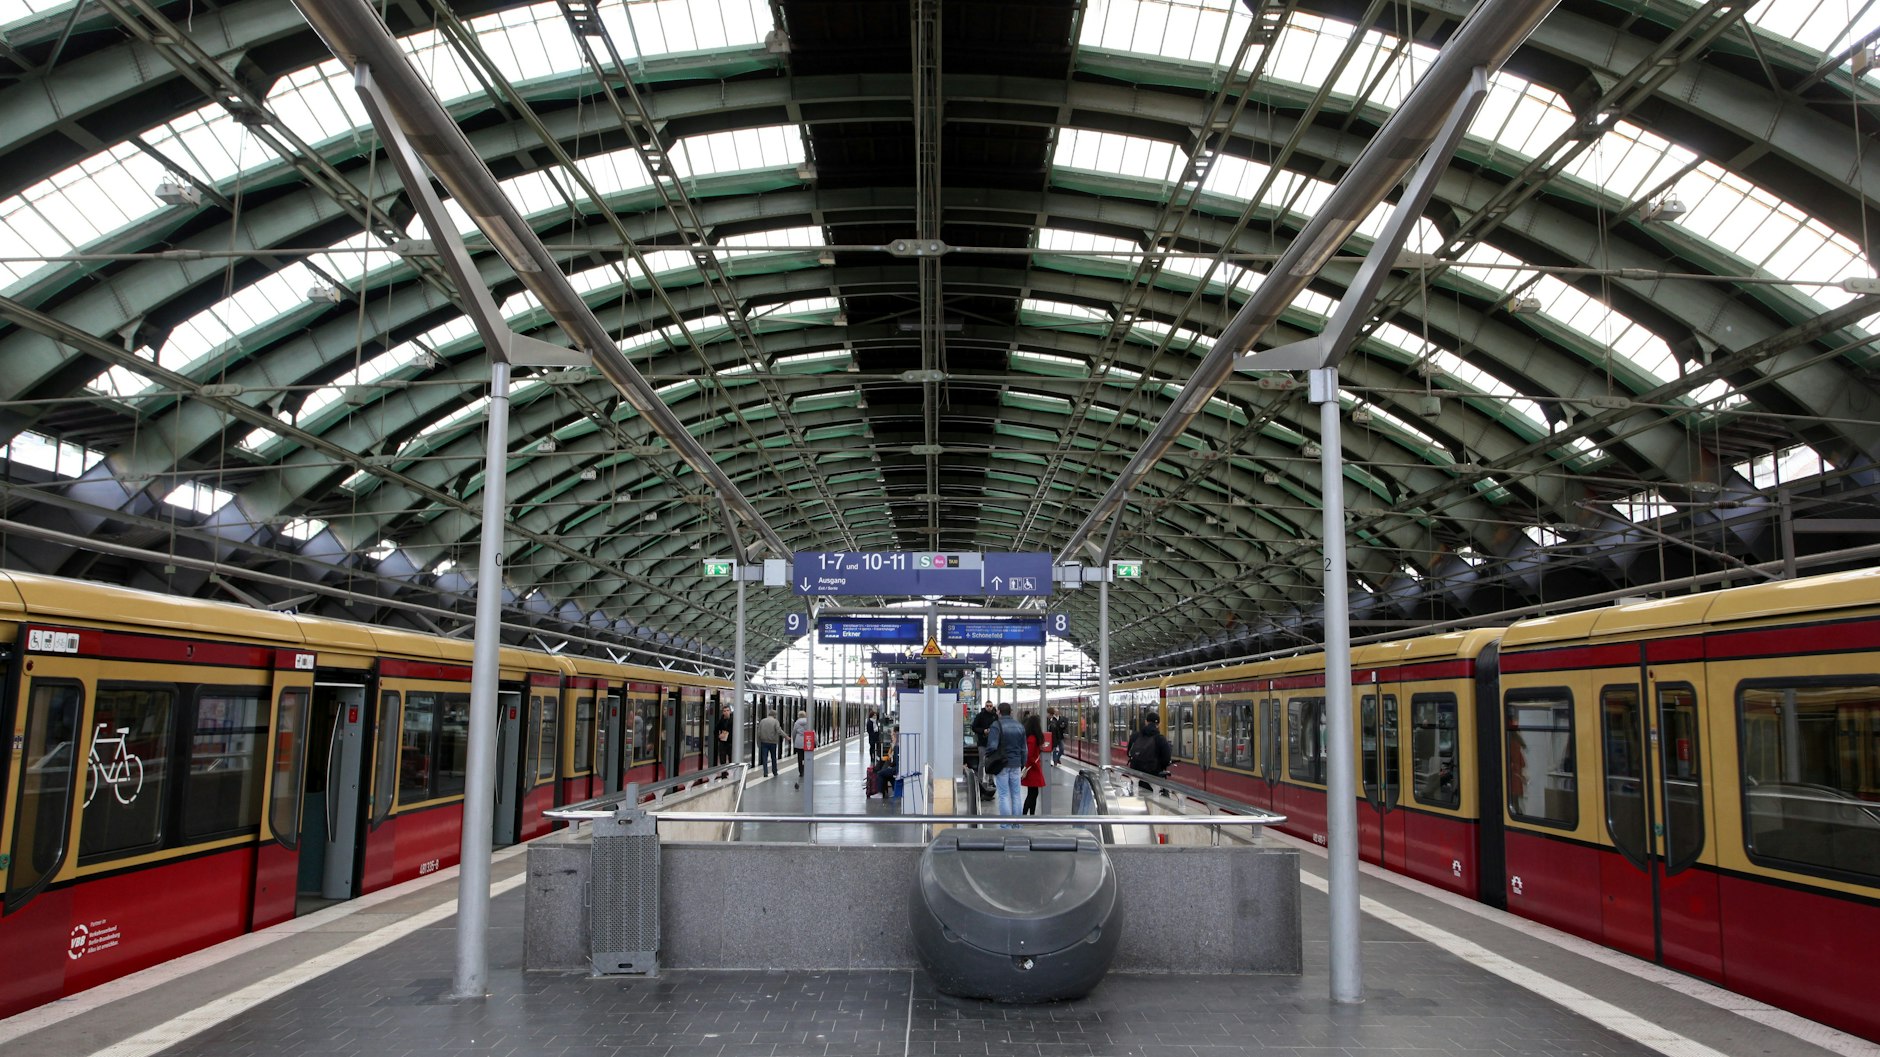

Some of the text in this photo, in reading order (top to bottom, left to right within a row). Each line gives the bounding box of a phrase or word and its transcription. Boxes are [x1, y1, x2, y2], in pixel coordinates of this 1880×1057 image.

[818, 553, 905, 570] 1-7 und 10-11
[920, 555, 931, 568] S
[1324, 557, 1332, 572] 2
[818, 576, 846, 585] Ausgang
[787, 613, 800, 630] 9
[1055, 614, 1067, 631] 8
[71, 935, 87, 949] VBB
